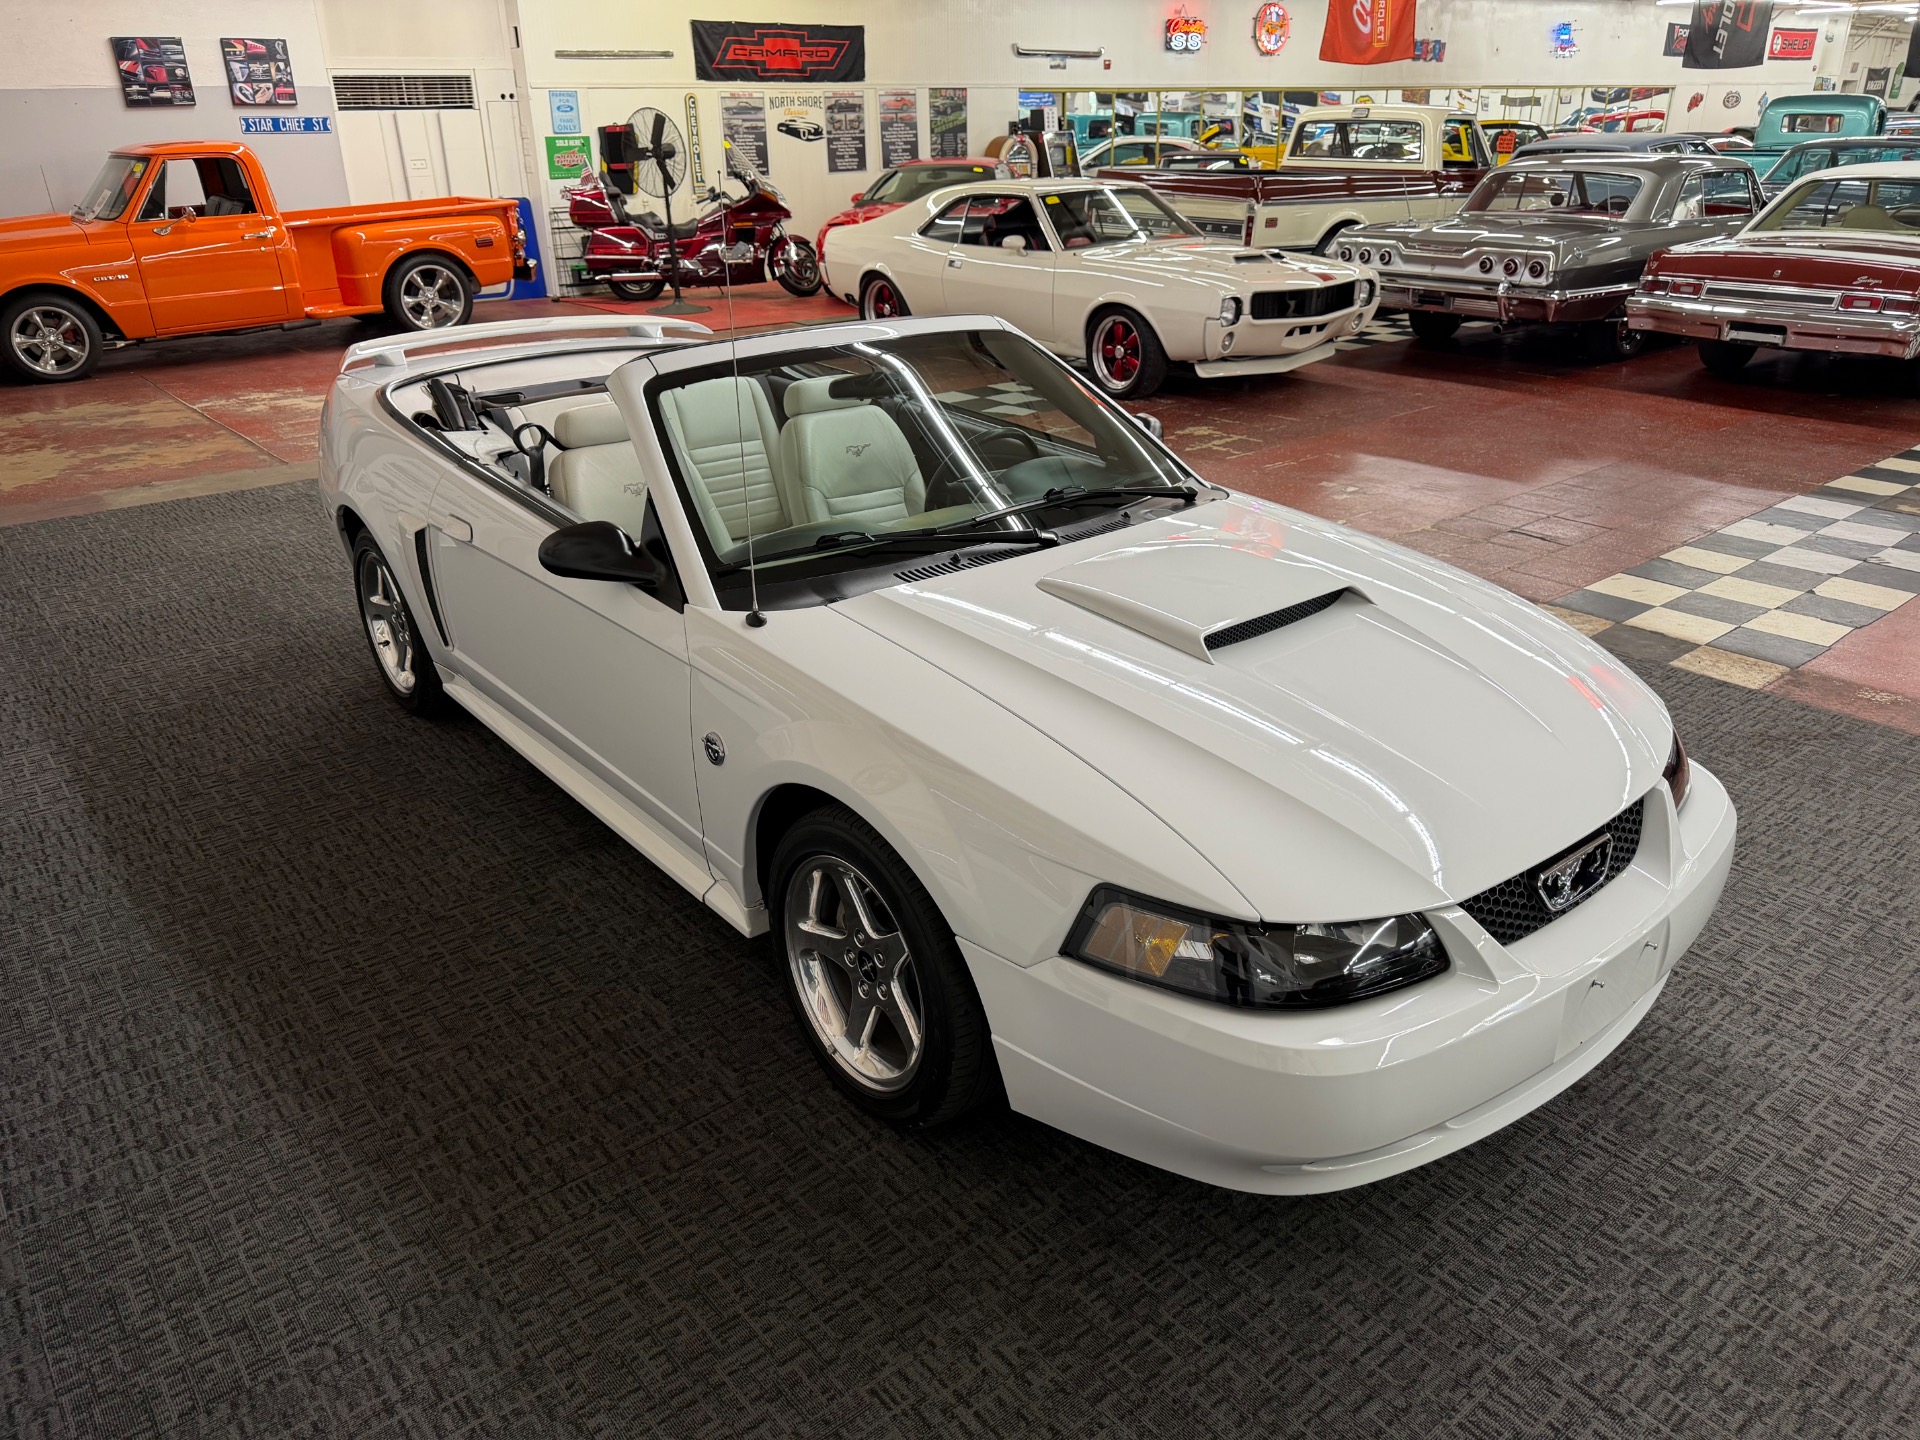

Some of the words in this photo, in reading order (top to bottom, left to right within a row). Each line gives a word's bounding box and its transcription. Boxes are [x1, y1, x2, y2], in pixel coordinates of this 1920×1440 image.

[1266, 6, 1284, 15] FORD
[1376, 0, 1386, 40] ROLET
[1712, 0, 1736, 60] OLET
[1170, 32, 1202, 50] SS
[1781, 38, 1813, 51] SHELBY
[733, 47, 830, 59] CAMARO
[768, 96, 795, 110] NORTH
[797, 96, 823, 109] SHORE
[248, 118, 274, 132] STAR
[279, 117, 305, 131] CHIEF
[312, 117, 324, 131] ST
[557, 123, 577, 131] ONLY
[688, 97, 703, 182] CHEVROLET
[1106, 216, 1228, 232] CEVRET
